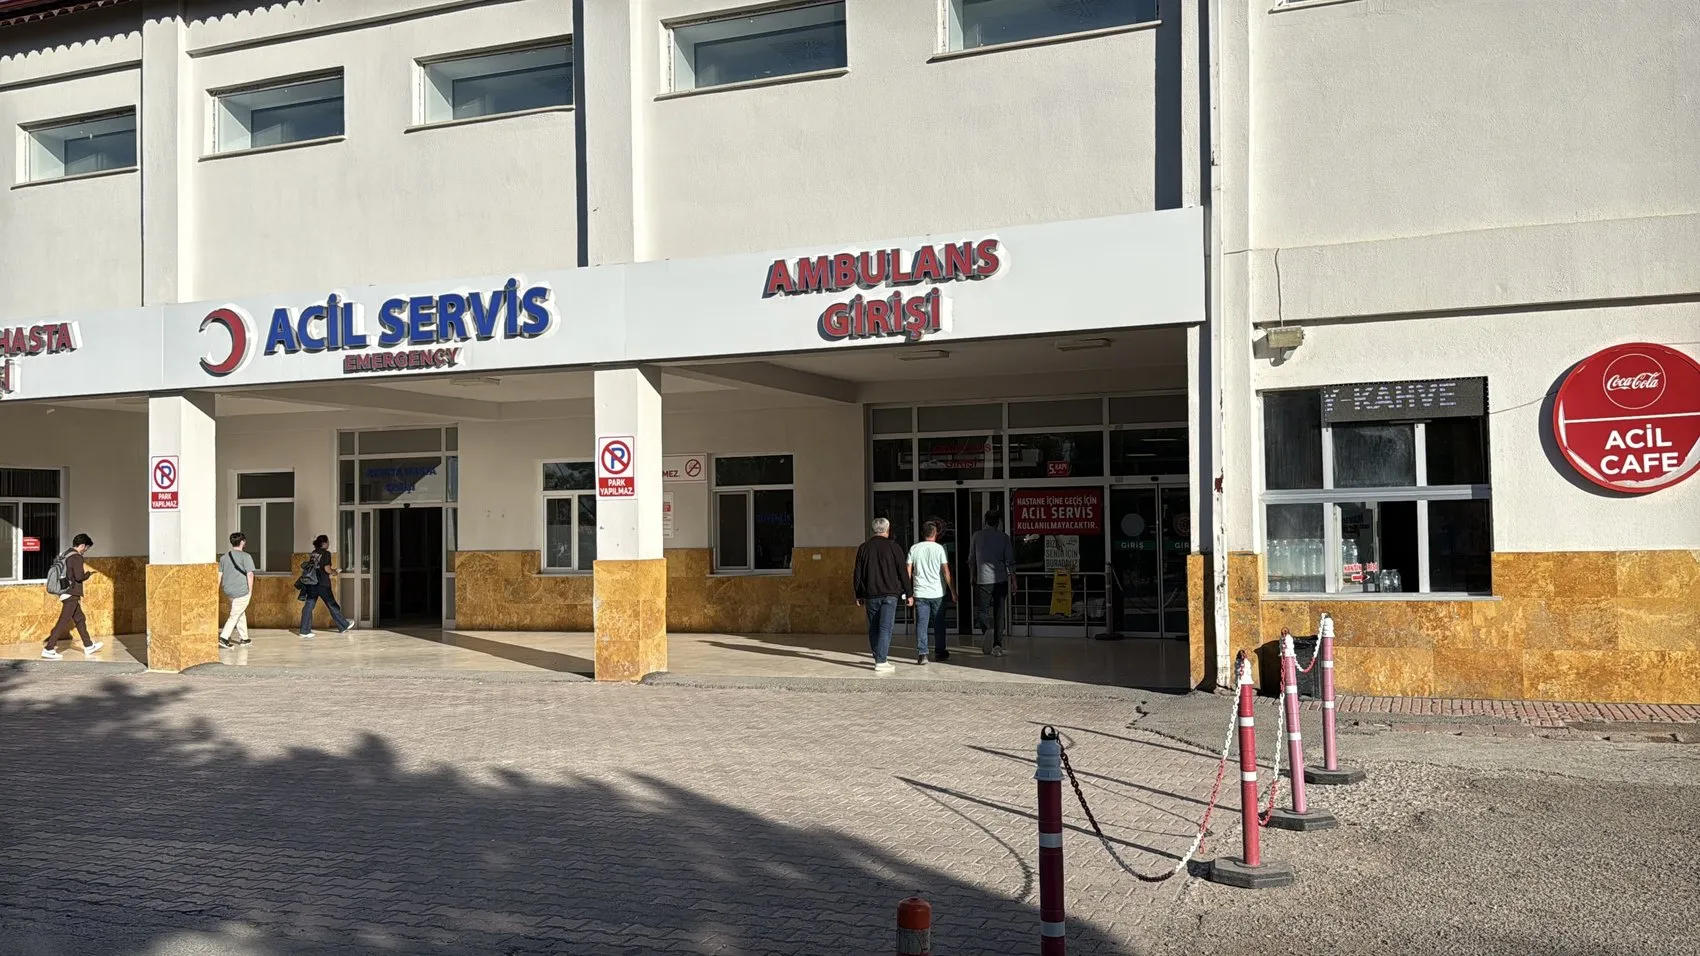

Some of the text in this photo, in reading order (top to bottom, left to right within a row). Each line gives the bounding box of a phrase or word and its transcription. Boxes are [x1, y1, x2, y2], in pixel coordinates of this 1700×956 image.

[767, 239, 1000, 294] AMBULANS
[265, 277, 552, 353] ACİL SERVİS
[822, 286, 942, 340] GİRİŞİ
[344, 347, 459, 373] EMERGENCY
[1606, 371, 1661, 391] Coca-Cola
[1604, 423, 1673, 450] ACİL
[1600, 452, 1680, 475] CAFE
[608, 478, 626, 487] PARK
[1017, 497, 1045, 505] HASTANE
[1021, 506, 1047, 519] ACİL
[1017, 521, 1098, 530] KULLANILMAYACAKTIR.
